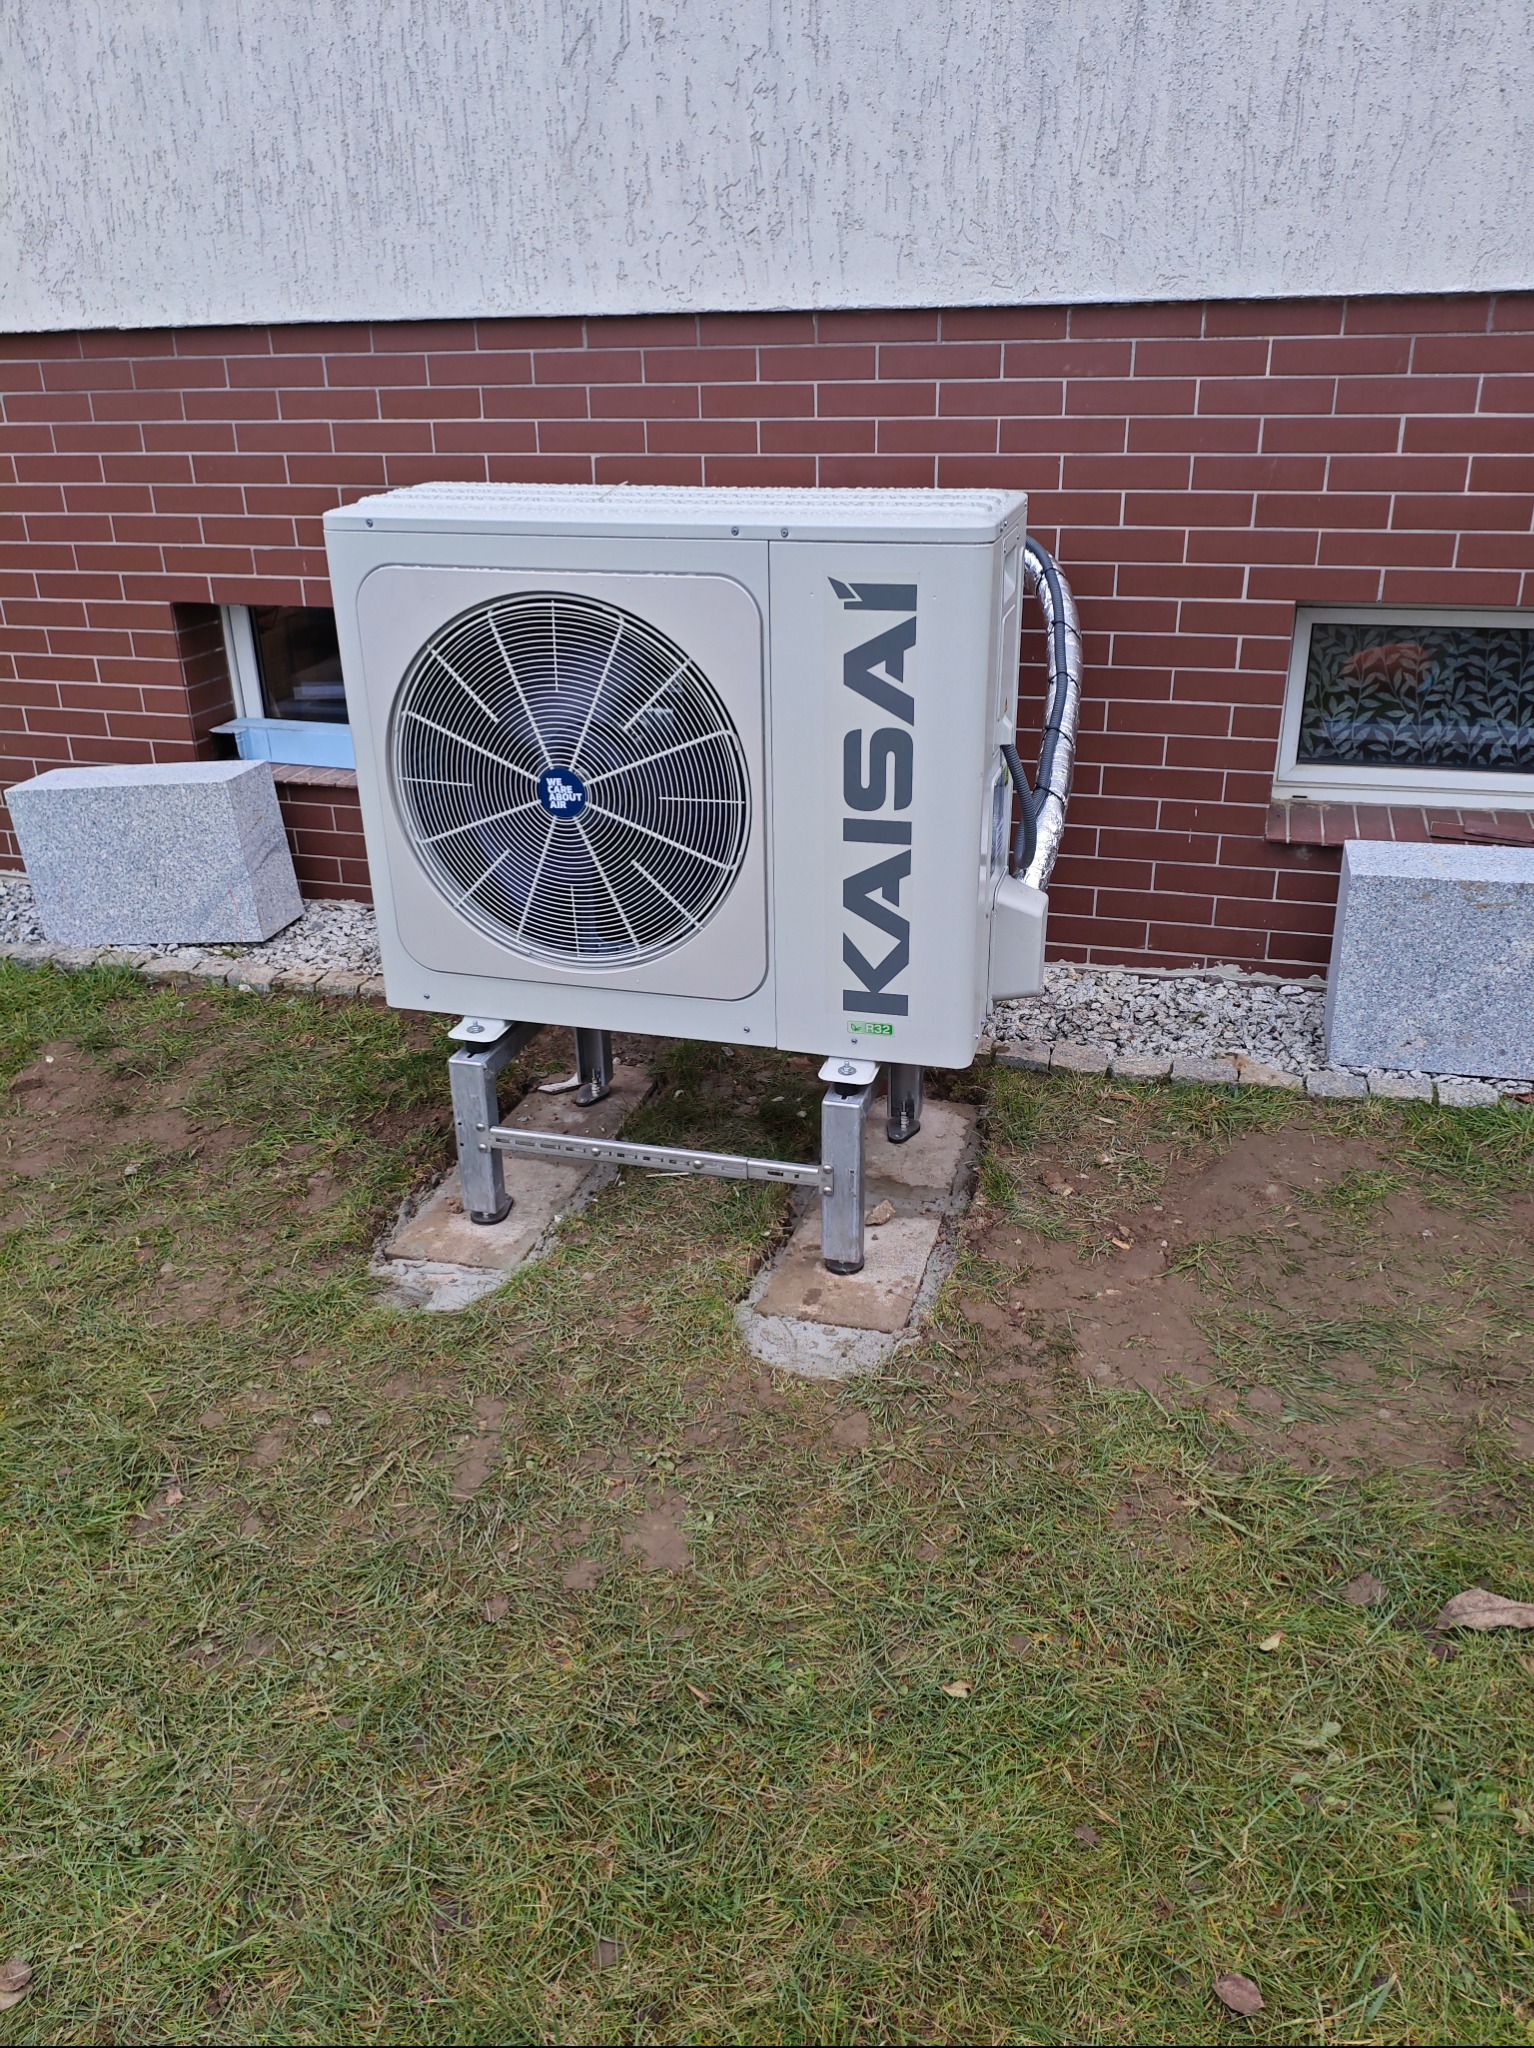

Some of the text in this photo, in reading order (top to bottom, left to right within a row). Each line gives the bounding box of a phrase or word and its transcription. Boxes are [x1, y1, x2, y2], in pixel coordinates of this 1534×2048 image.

[546, 778, 562, 786] WE
[547, 785, 573, 793] CARE
[549, 793, 582, 801] ABOUT
[827, 576, 917, 1016] KAISAI
[865, 1023, 891, 1034] R32
